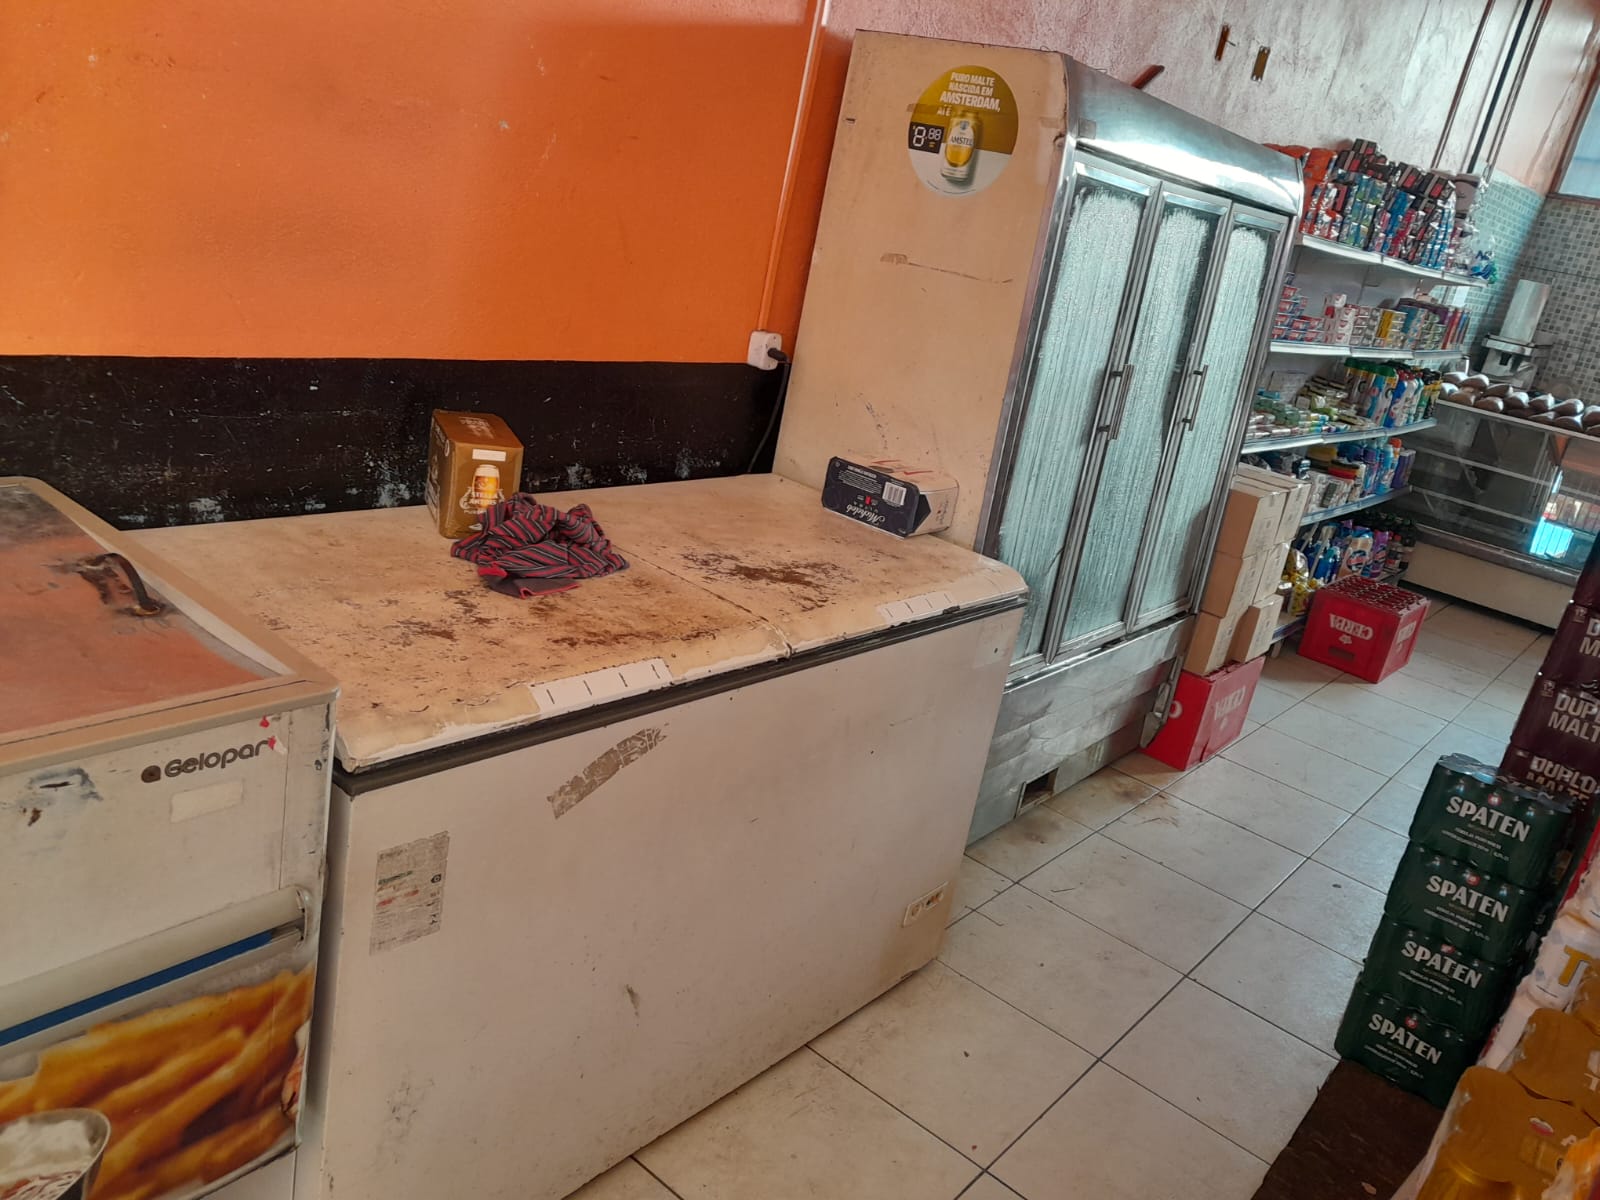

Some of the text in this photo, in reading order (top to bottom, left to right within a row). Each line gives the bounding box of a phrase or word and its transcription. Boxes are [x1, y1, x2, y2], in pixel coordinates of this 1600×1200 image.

[949, 82, 993, 96] NASCIDA EM
[951, 72, 995, 86] PURO MALTE
[1547, 709, 1600, 743] MALT
[1446, 795, 1531, 843] SPATEN
[1425, 874, 1510, 923] SPATEN
[1401, 940, 1483, 990] SPATEN
[1368, 1013, 1443, 1066] SPATEN
